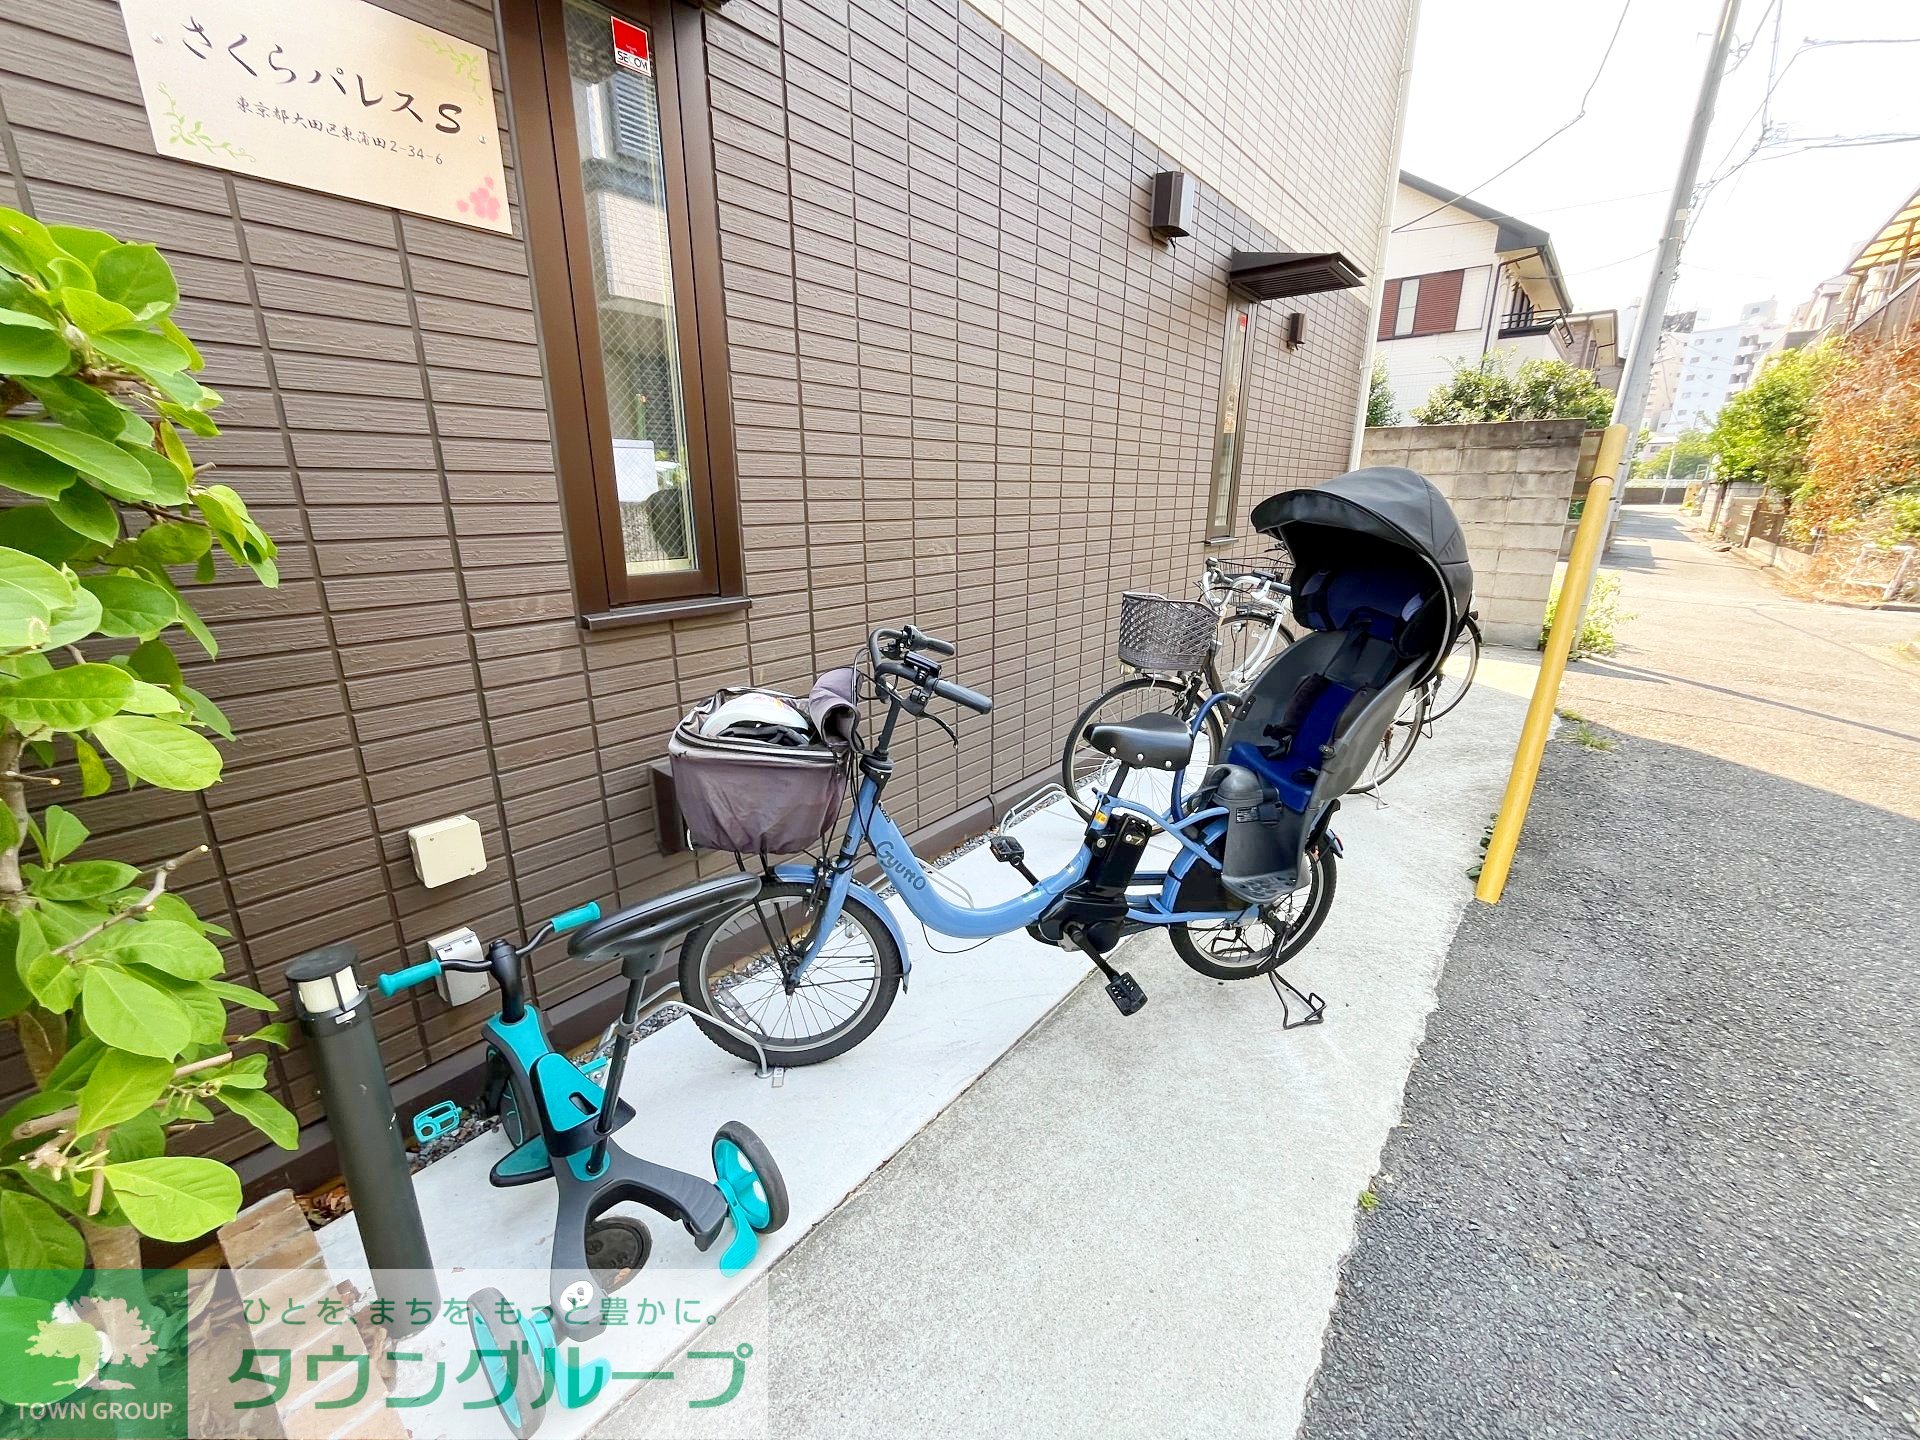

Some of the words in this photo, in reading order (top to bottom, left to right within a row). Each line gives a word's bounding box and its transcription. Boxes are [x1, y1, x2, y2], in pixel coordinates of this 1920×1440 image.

[180, 16, 462, 134] さくらパレスS
